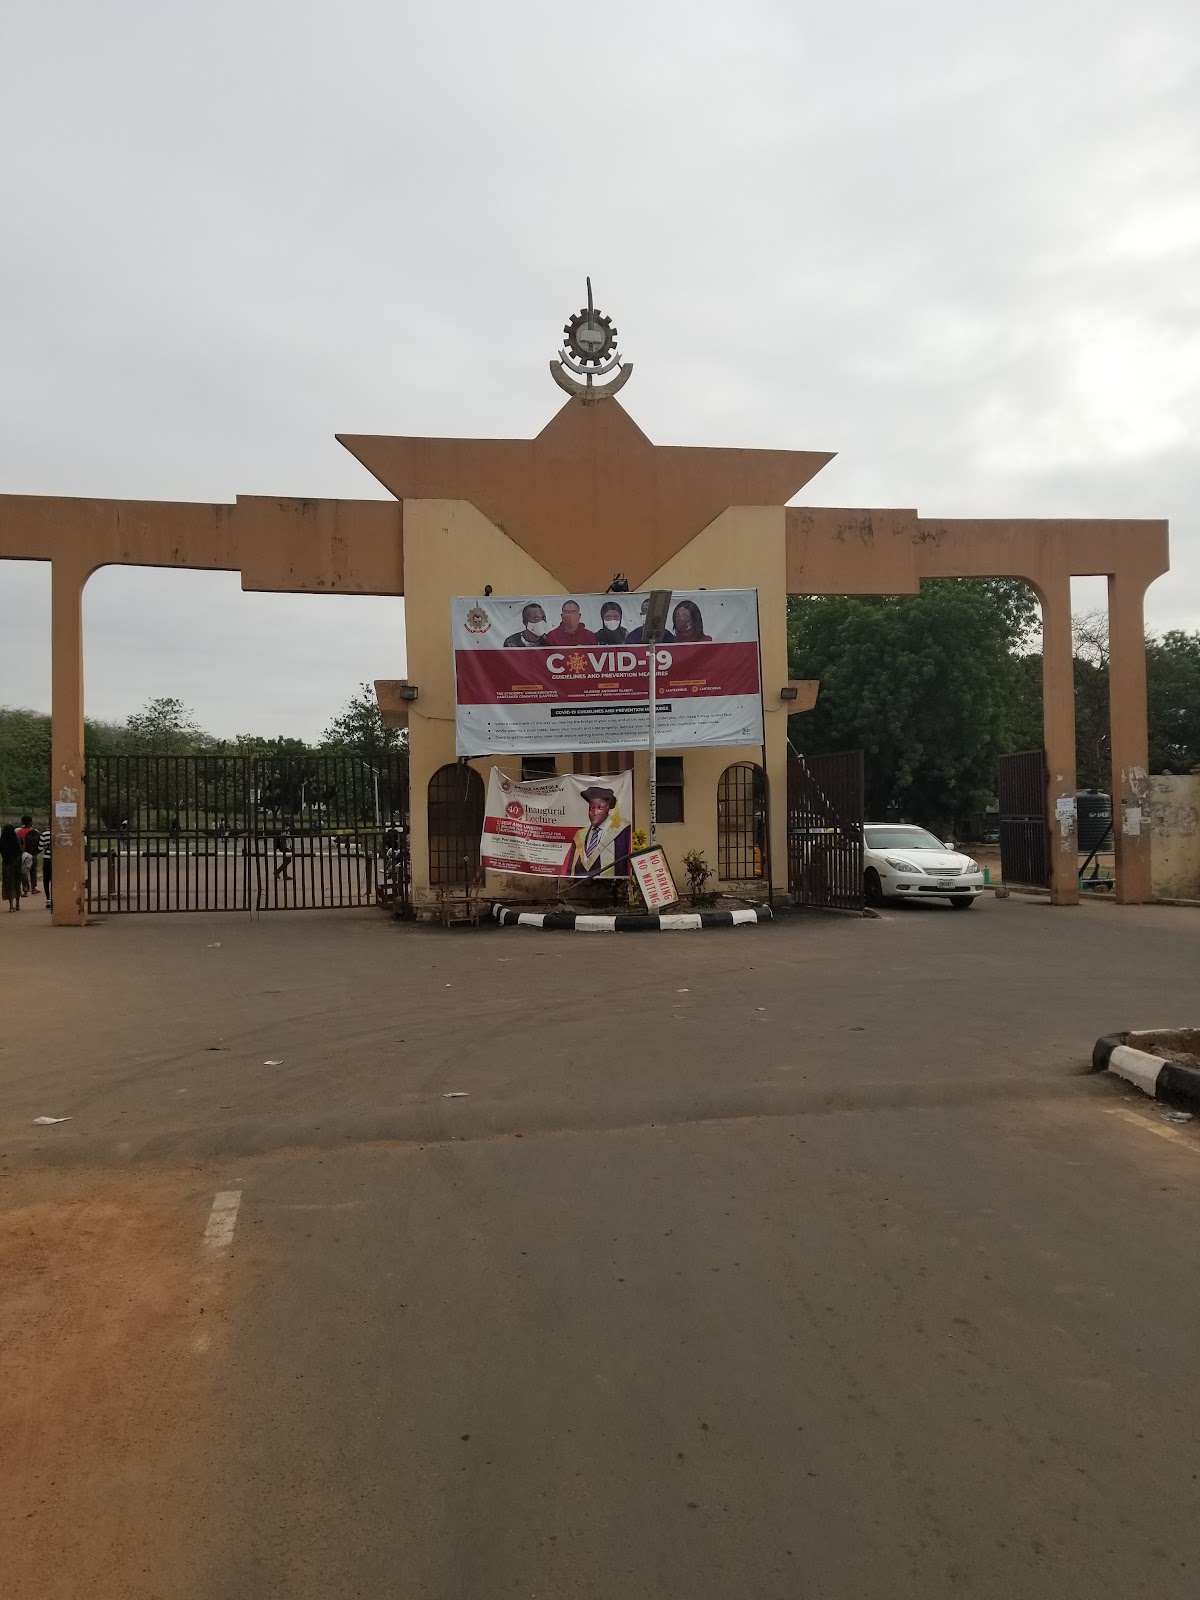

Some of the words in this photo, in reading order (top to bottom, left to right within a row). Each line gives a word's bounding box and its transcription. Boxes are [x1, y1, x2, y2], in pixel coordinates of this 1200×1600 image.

[546, 650, 672, 673] COVID-9
[508, 806, 518, 814] 40
[525, 805, 565, 816] Inaugural
[525, 813, 557, 824] Lecture
[637, 859, 648, 870] NO
[649, 854, 660, 864] NO
[655, 868, 672, 900] PARKING
[642, 873, 660, 903] WAITING
